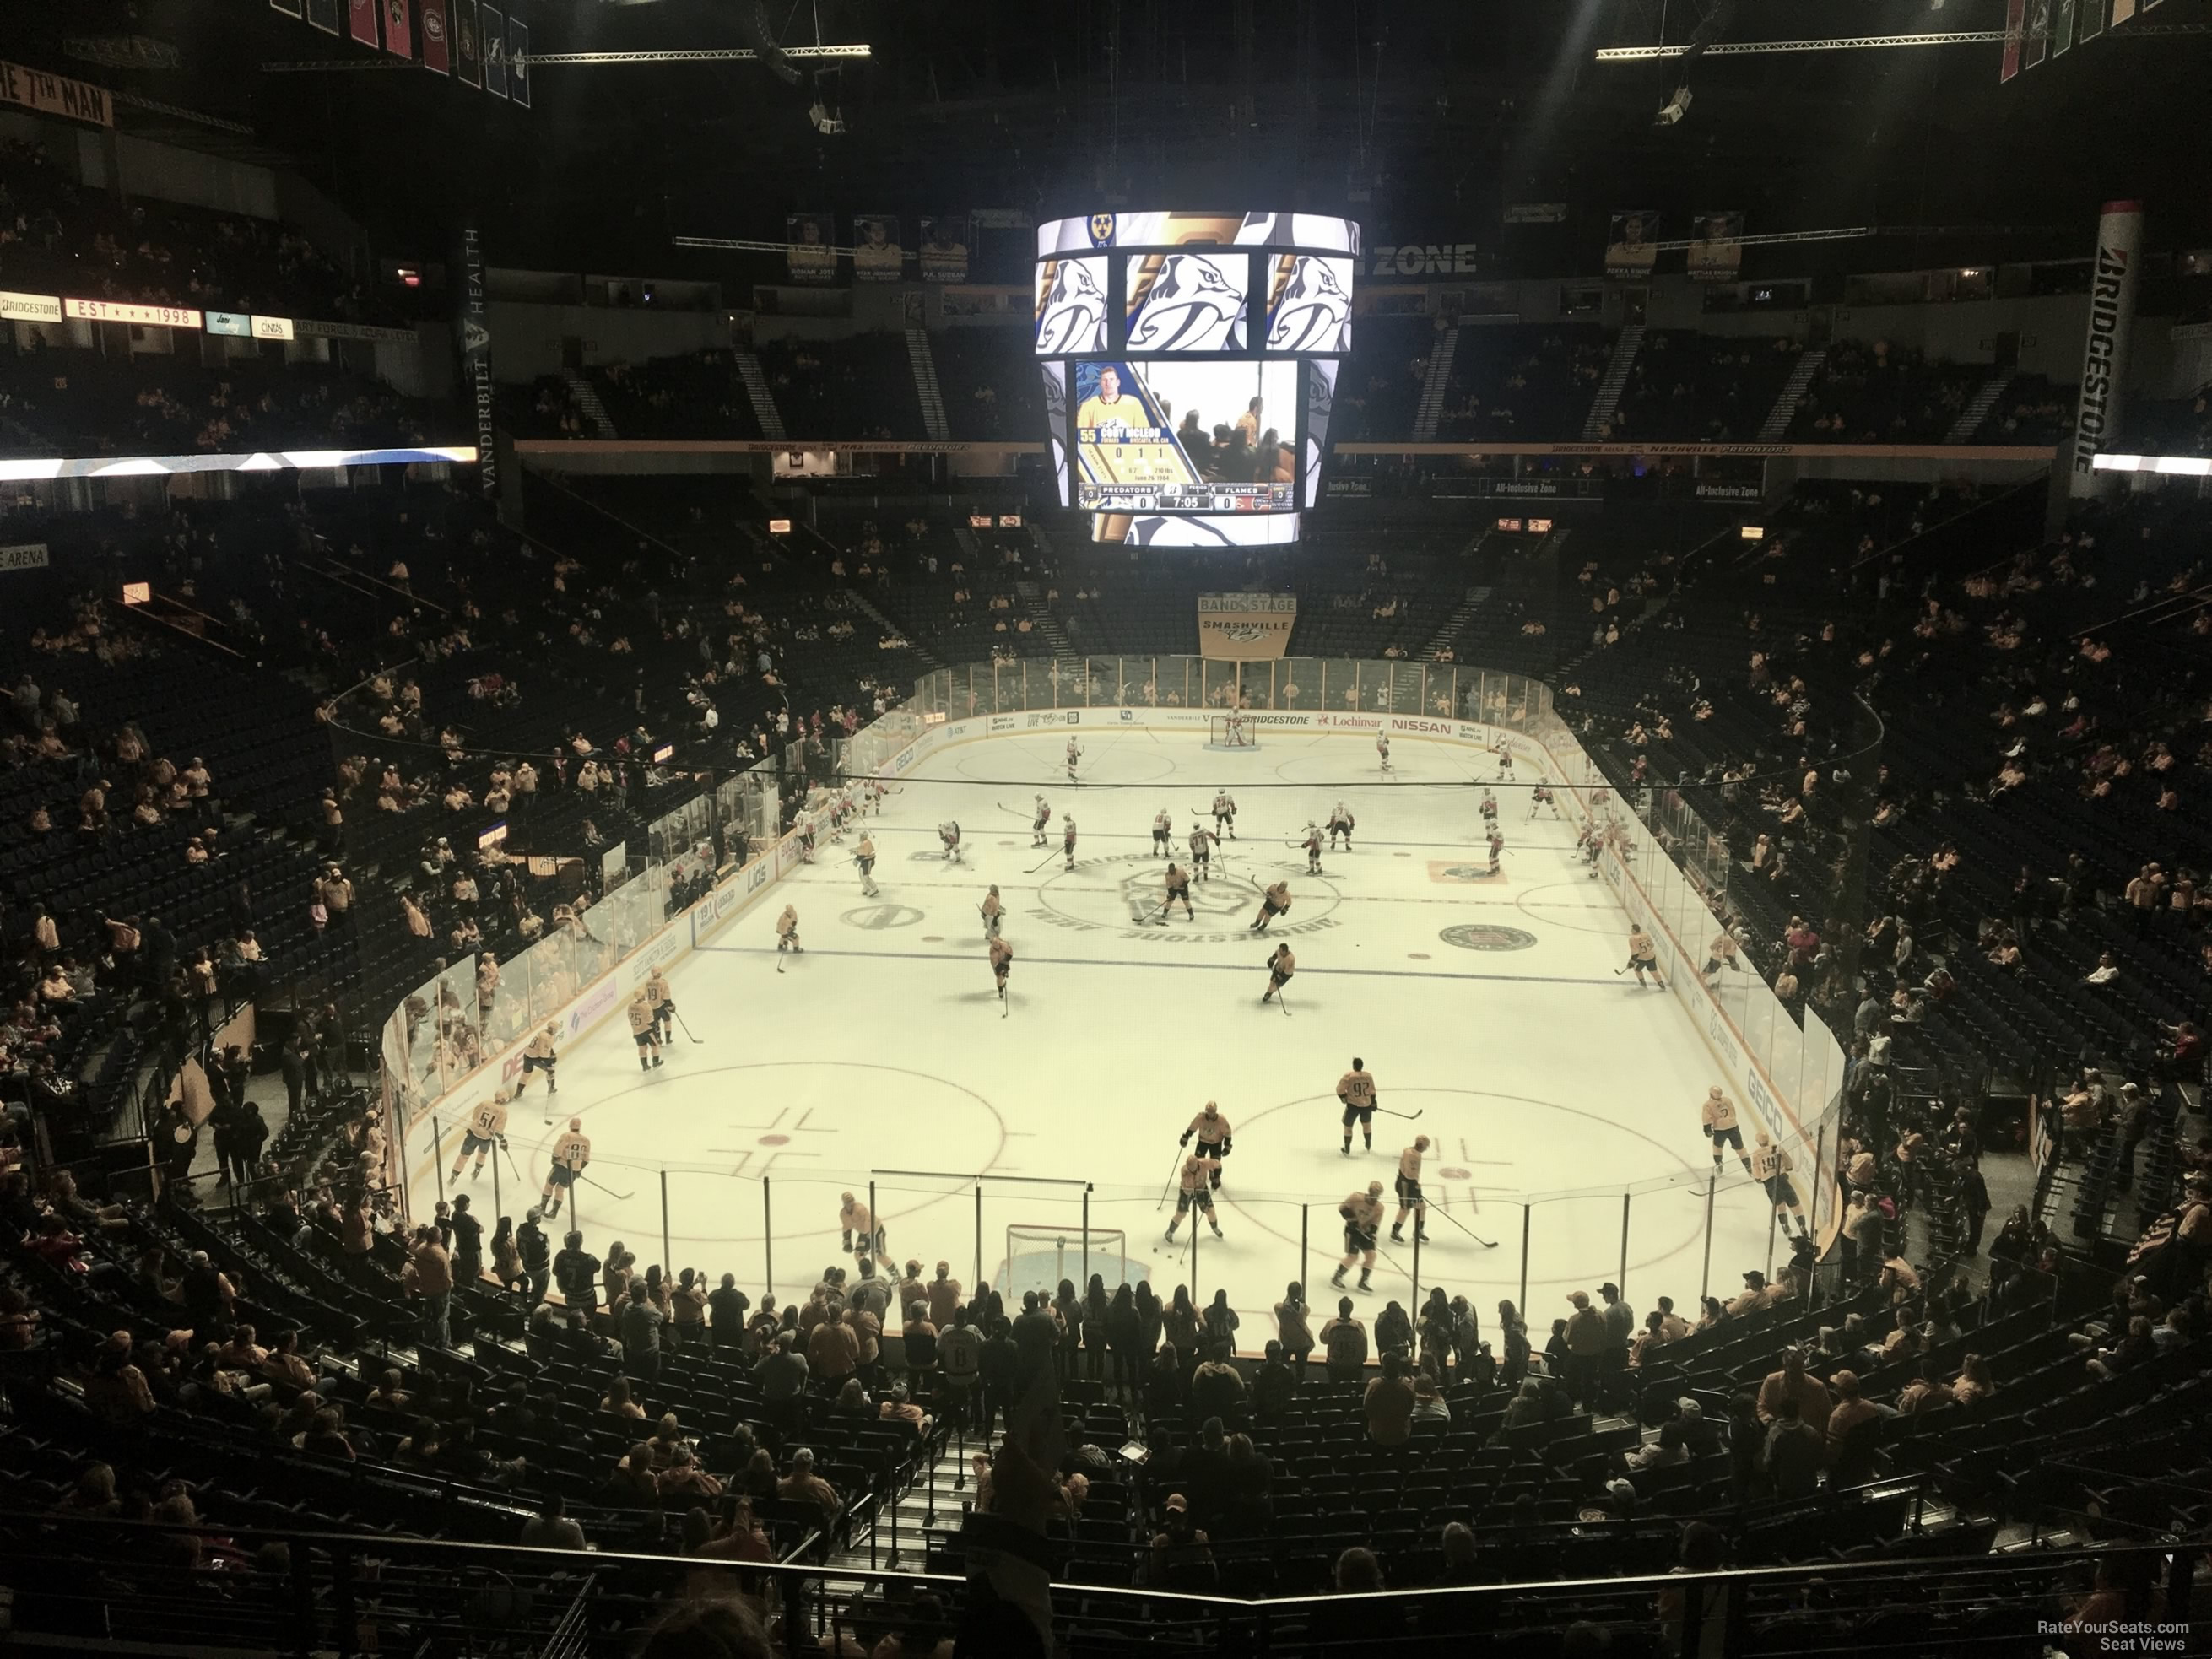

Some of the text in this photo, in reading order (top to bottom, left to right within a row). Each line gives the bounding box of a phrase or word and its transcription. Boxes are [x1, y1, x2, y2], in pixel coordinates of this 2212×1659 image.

[61, 80, 104, 122] MAN
[1372, 243, 1477, 276] ZONE
[465, 229, 484, 314] HEALTH
[2, 299, 59, 316] BRIDGESTONE
[78, 301, 189, 325] EST 1998
[2075, 246, 2127, 474] BRIDGESTONE
[473, 359, 496, 490] VANDERBILT
[1080, 429, 1096, 443] 55
[1116, 447, 1122, 458] 0
[1495, 483, 1557, 494] All-Inclusive Zone
[1696, 485, 1759, 497] All-Inclusive Zone
[1139, 497, 1147, 509] 0
[1174, 496, 1198, 508] 7:05
[1223, 497, 1230, 509] 0
[8, 550, 44, 566] ARENA
[1252, 600, 1295, 611] STAGE
[1203, 620, 1290, 630] SMASHVILLE
[1242, 715, 1310, 725] BRIDGESTONE
[1333, 716, 1383, 728] Lochinvar
[1392, 719, 1452, 734] NISSAN
[954, 726, 967, 735] AT&T
[895, 747, 914, 771] GEICO
[747, 863, 766, 894] Lids
[647, 987, 657, 1001] 19
[1353, 1082, 1370, 1098] 92
[1748, 1067, 1783, 1142] GEICO
[479, 1111, 496, 1130] 51
